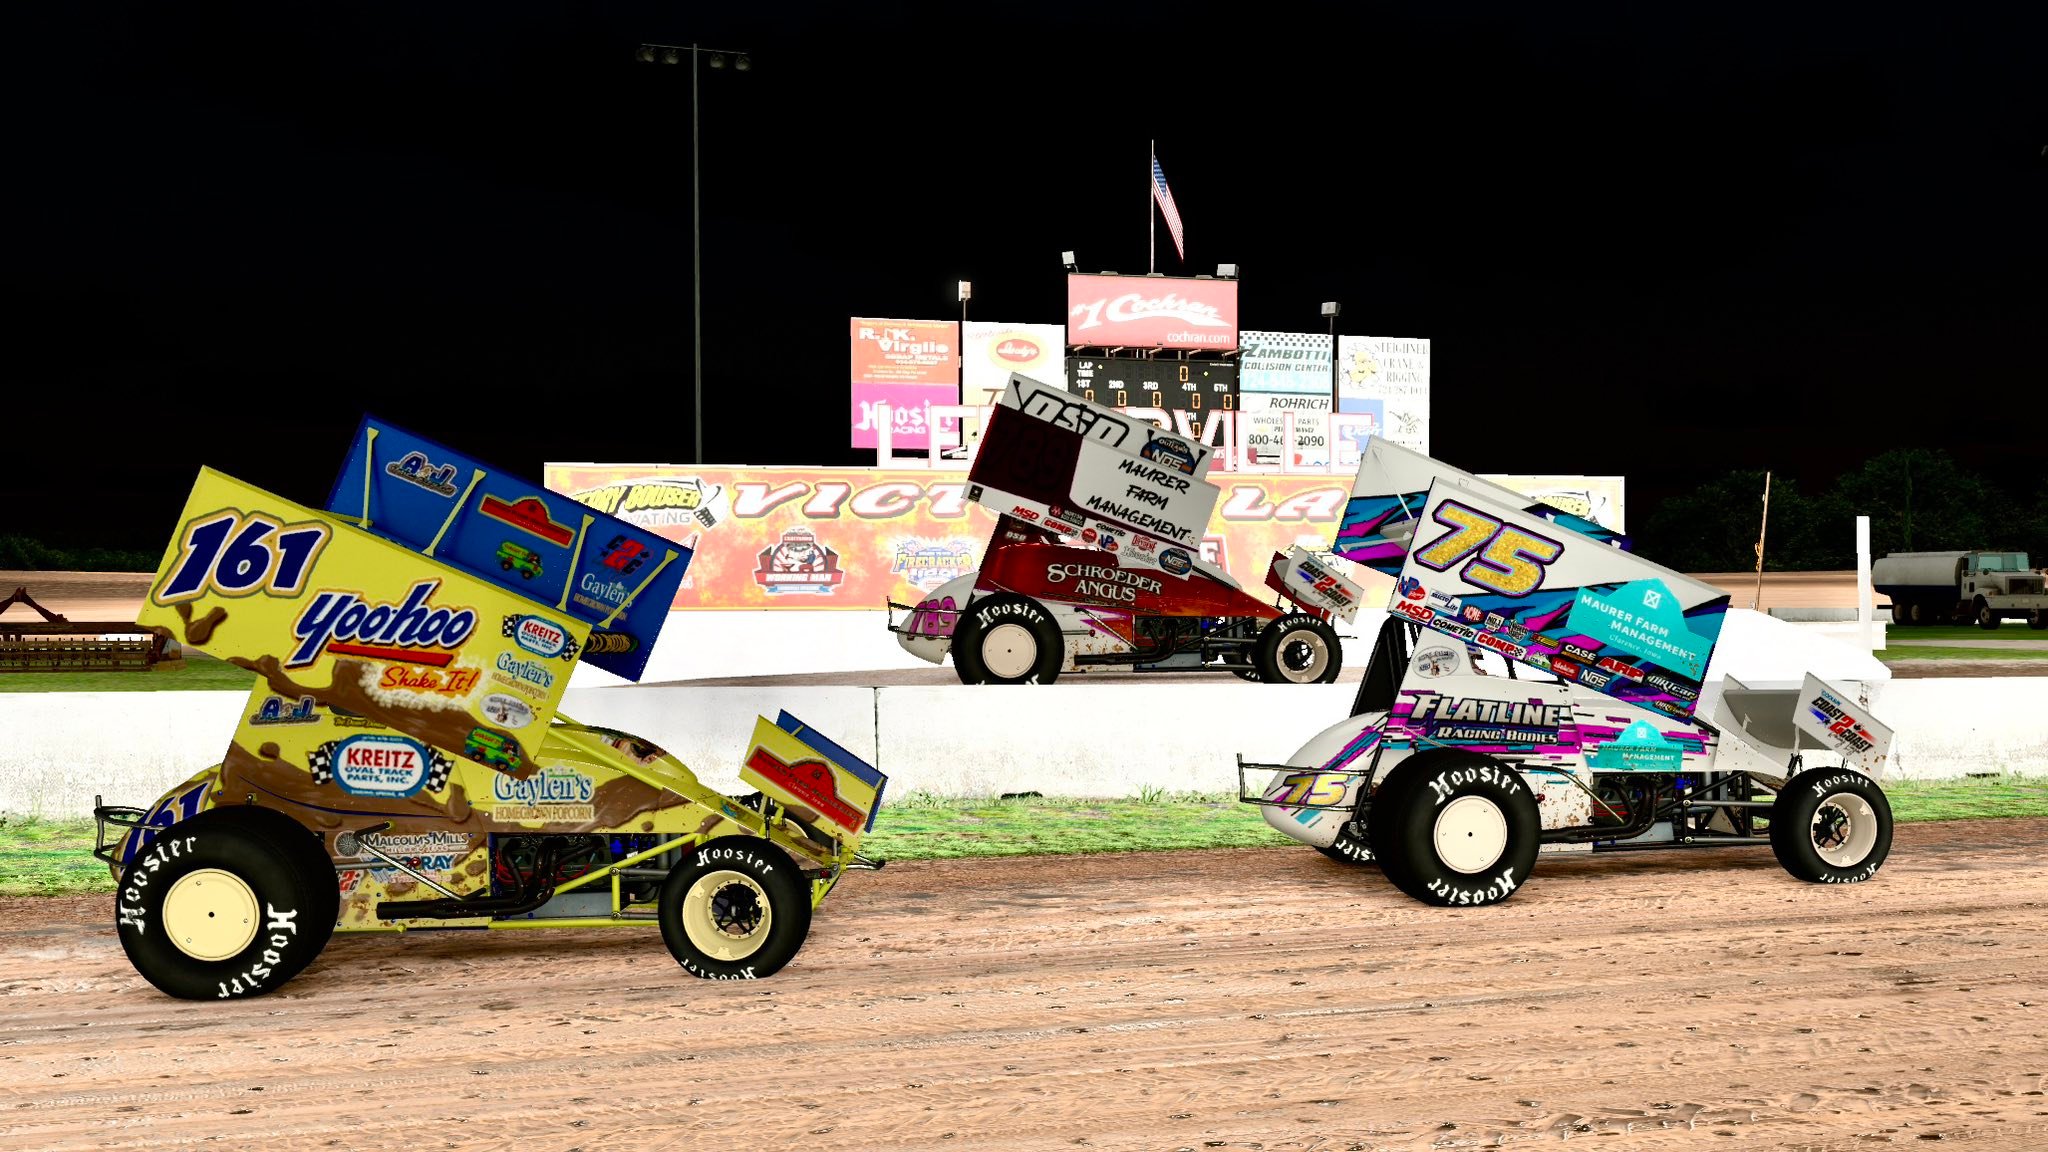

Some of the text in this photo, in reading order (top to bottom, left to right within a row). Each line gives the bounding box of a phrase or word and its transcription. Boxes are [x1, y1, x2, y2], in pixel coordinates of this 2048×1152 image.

[1106, 293, 1229, 326] Cochran
[1167, 331, 1230, 344] cochran.com
[1244, 343, 1330, 361] ZAMBOTTI
[1077, 369, 1094, 377] TIME
[1079, 361, 1093, 370] LAP
[1244, 362, 1291, 371] COLLISION
[1295, 364, 1328, 372] CENTER
[1076, 379, 1091, 388] 1ST
[1108, 380, 1124, 389] 2ND
[1142, 381, 1159, 390] 3RD
[1181, 383, 1197, 391] 4TH
[1269, 398, 1330, 410] ROHRICH
[1248, 433, 1325, 446] 800-4-2090
[1152, 449, 1187, 470] NOS
[1118, 458, 1191, 495] MAURER
[1126, 484, 1170, 510] FARM
[1012, 506, 1040, 520] MSD
[1086, 495, 1193, 540] MANAGEMENT
[1043, 519, 1073, 534] COMP
[1095, 522, 1127, 537] COMETIC
[1100, 534, 1115, 549] VP
[1414, 500, 1564, 598] 75
[155, 511, 330, 603] 161
[1047, 563, 1162, 595] SCHROEDER
[1298, 561, 1329, 580] COAST
[1074, 580, 1136, 602] ANGUS
[1313, 576, 1338, 593] 2
[1401, 576, 1420, 598] VP
[1323, 587, 1353, 607] COAST
[976, 603, 1044, 630] Hoosier
[1395, 600, 1433, 620] MSD
[1581, 594, 1669, 638] MAURER FARM
[524, 621, 562, 644] KREITZ
[1278, 617, 1322, 633] Hoosier
[1432, 618, 1475, 638] COMETIC
[1477, 633, 1515, 654] COMP
[1610, 620, 1697, 661] MANAGEMENT
[1564, 644, 1597, 661] CASE
[381, 665, 480, 692] Shake It!
[496, 651, 554, 689] Gaylen's
[1580, 669, 1610, 687] NOS
[1596, 657, 1645, 683] ARP
[1411, 694, 1560, 726] FLATLINE
[1811, 696, 1846, 721] COAST
[1437, 727, 1559, 744] RACING BODIES
[1828, 715, 1856, 735] 2
[1839, 729, 1874, 752] COAST
[347, 748, 415, 768] KREITZ
[1622, 753, 1675, 761] MANAGEMENT
[347, 774, 409, 784] PARTS, INC.
[378, 768, 413, 776] TRACK
[494, 770, 592, 806] Gaylen's
[1281, 772, 1348, 805] 75
[1429, 765, 1522, 804] Hoosier
[1811, 774, 1871, 798] Hoosier
[495, 806, 592, 820] HOMEGROWN POPCORN
[365, 831, 468, 847] MALCOLM'S MILLS
[696, 847, 774, 875] Hoosier
[1820, 862, 1877, 884] Hoosier
[120, 835, 198, 935] Hoosier
[1427, 867, 1515, 906] Hoosier
[218, 902, 298, 999] Hoosier
[681, 958, 757, 980] Hoosier
